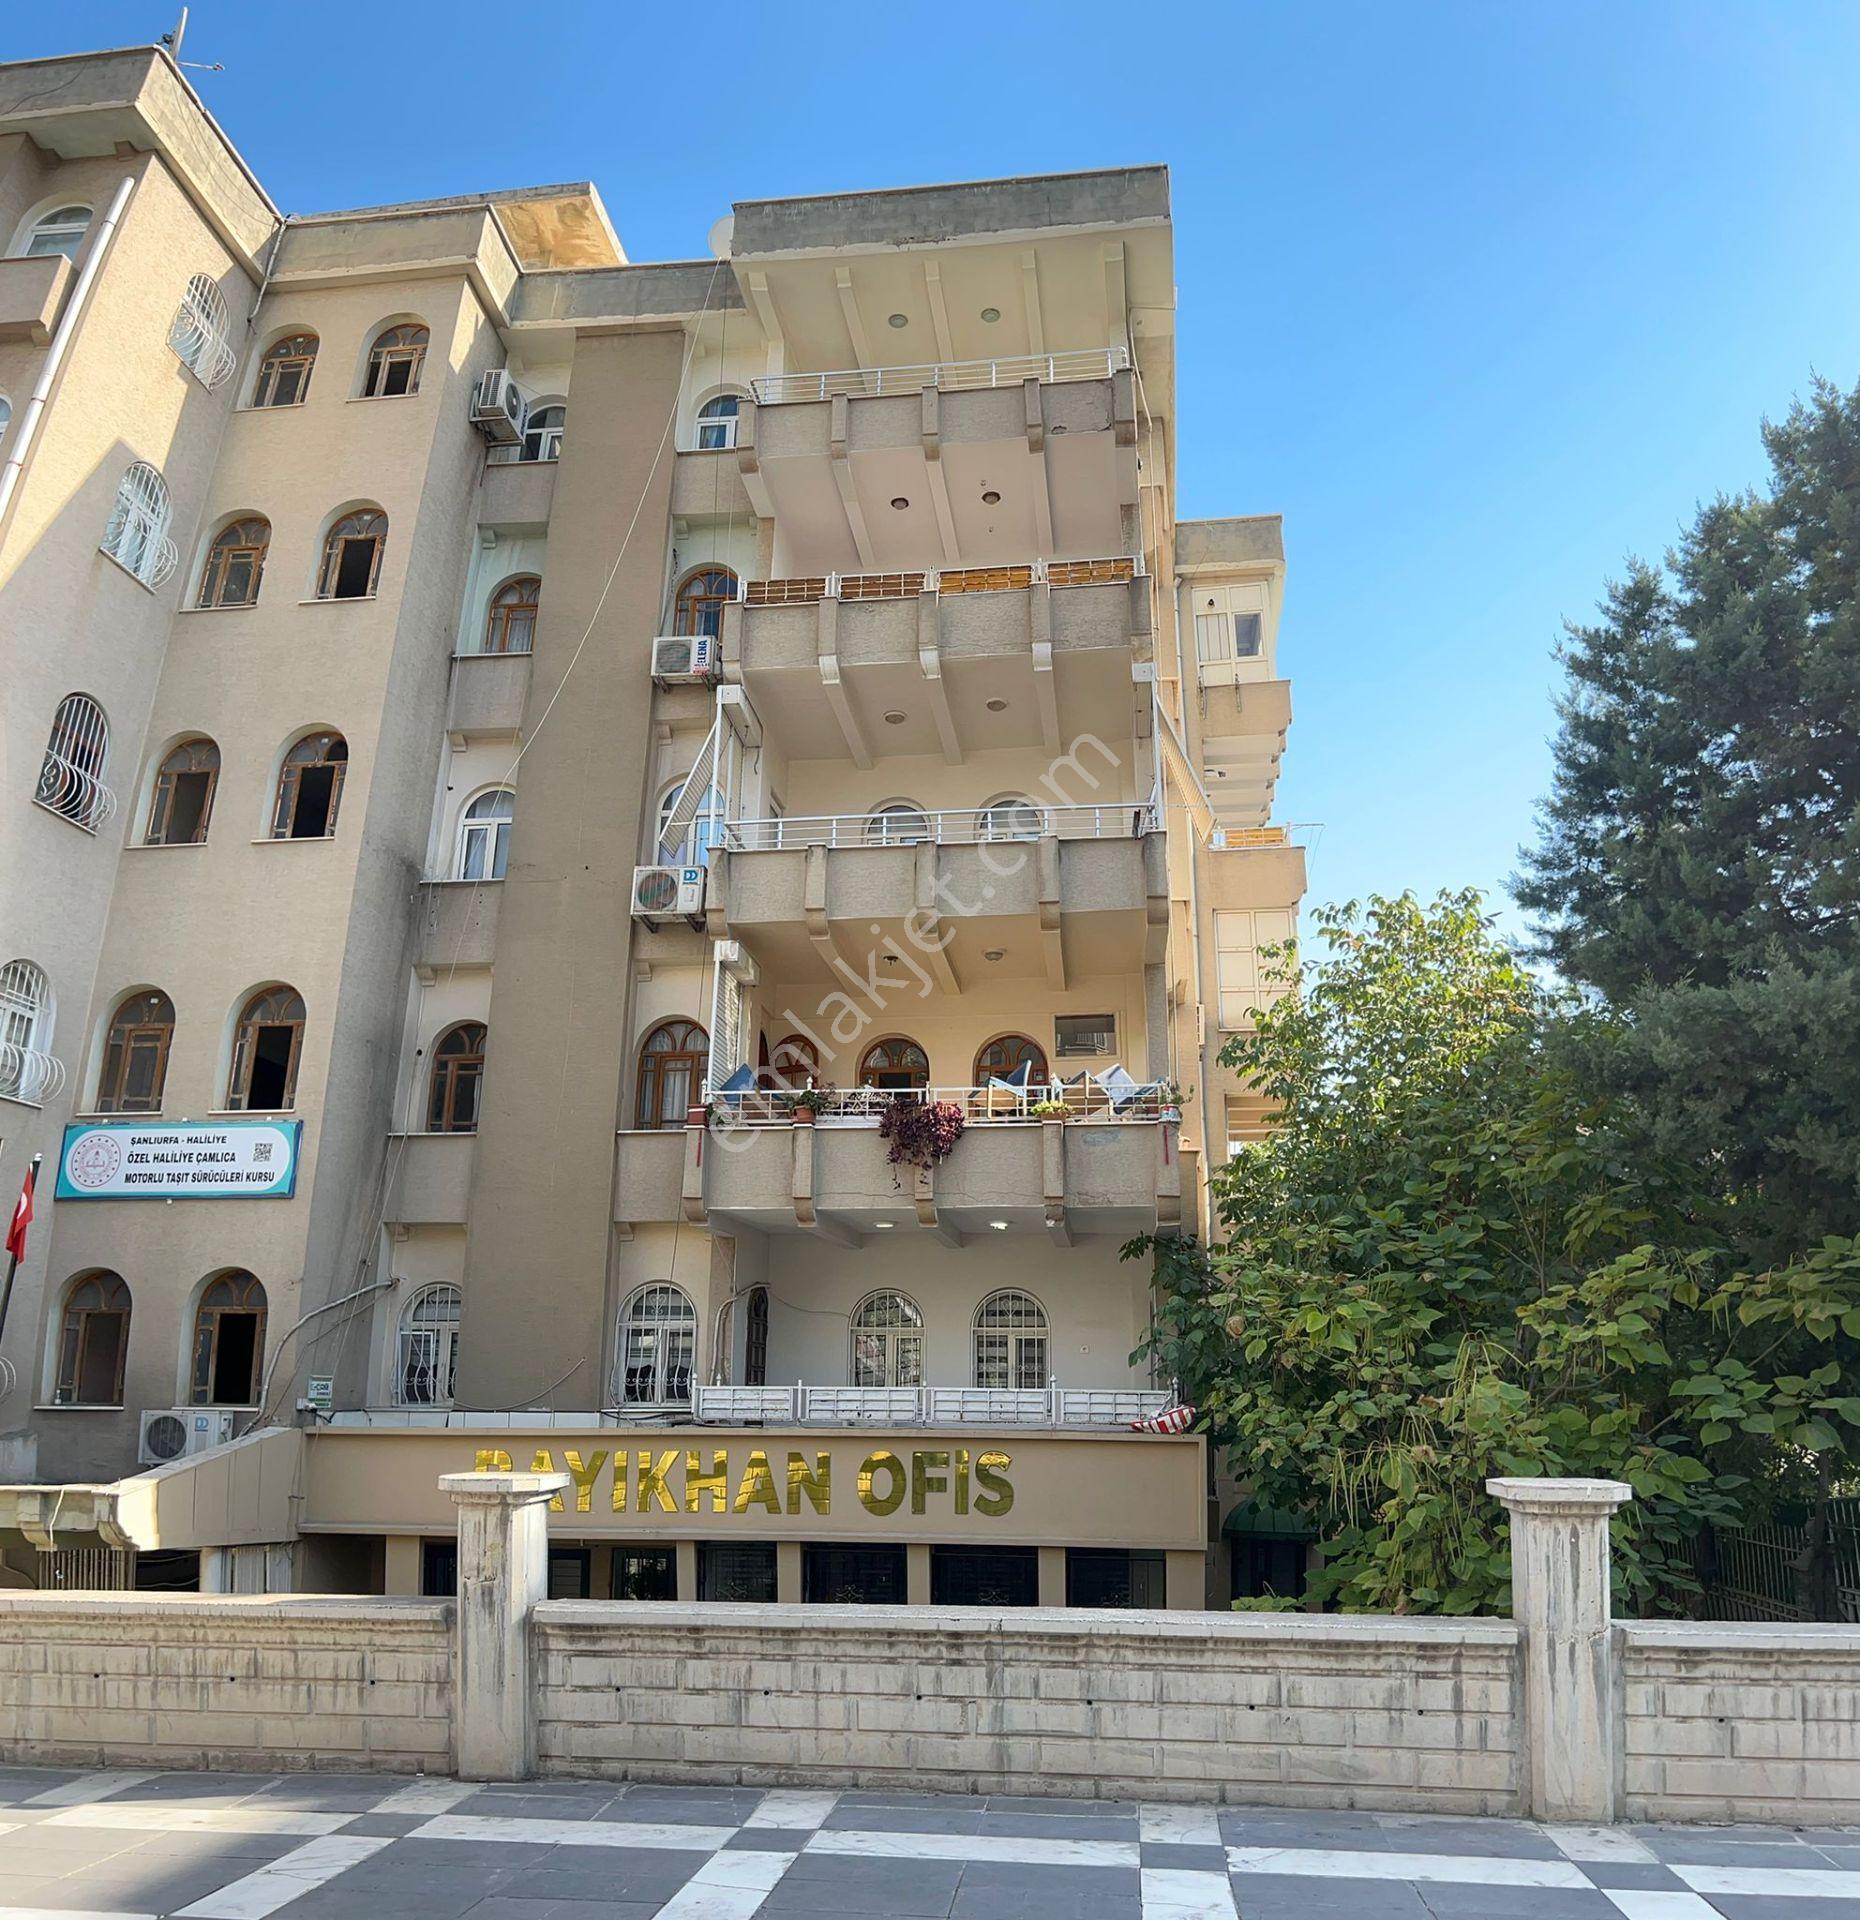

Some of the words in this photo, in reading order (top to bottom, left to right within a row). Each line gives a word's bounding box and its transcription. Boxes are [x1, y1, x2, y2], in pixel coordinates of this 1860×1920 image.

[130, 1136, 179, 1146] ŞANLIURFA
[186, 1133, 227, 1144] HALİLİYE
[127, 1150, 150, 1164] ÖZEL
[153, 1150, 194, 1163] HALİLİYE
[196, 1152, 236, 1165] ÇAMLICA
[124, 1172, 164, 1184] MOTORLU
[166, 1172, 190, 1186] TAŞIT
[191, 1169, 244, 1183] SÜRÜCÜLERİ
[245, 1171, 275, 1182] KURSU
